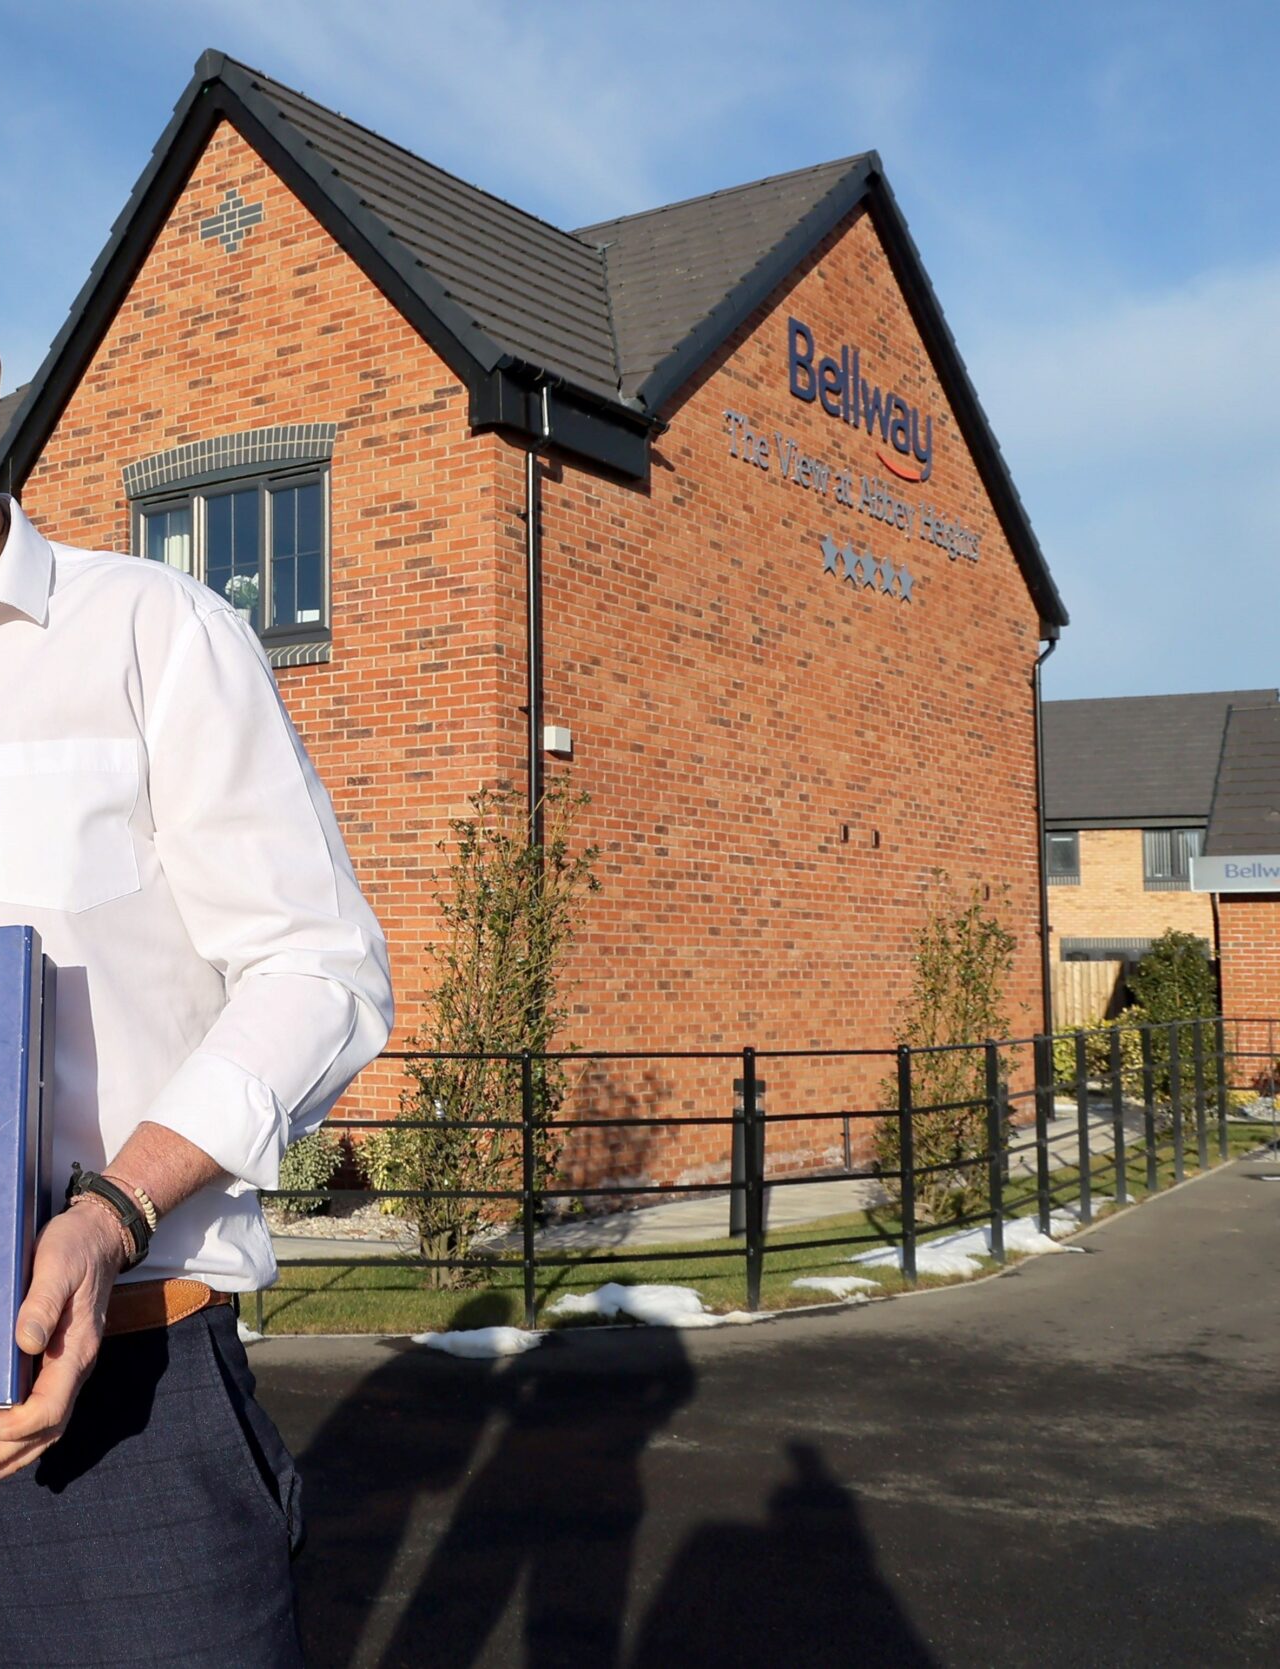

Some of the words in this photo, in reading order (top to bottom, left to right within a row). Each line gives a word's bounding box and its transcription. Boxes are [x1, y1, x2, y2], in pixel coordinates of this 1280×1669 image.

[788, 316, 933, 481] Bellway
[722, 409, 769, 471] The
[774, 431, 830, 496] View
[833, 468, 853, 508] at
[857, 474, 915, 542] Abbey
[1224, 863, 1280, 878] Bellw
